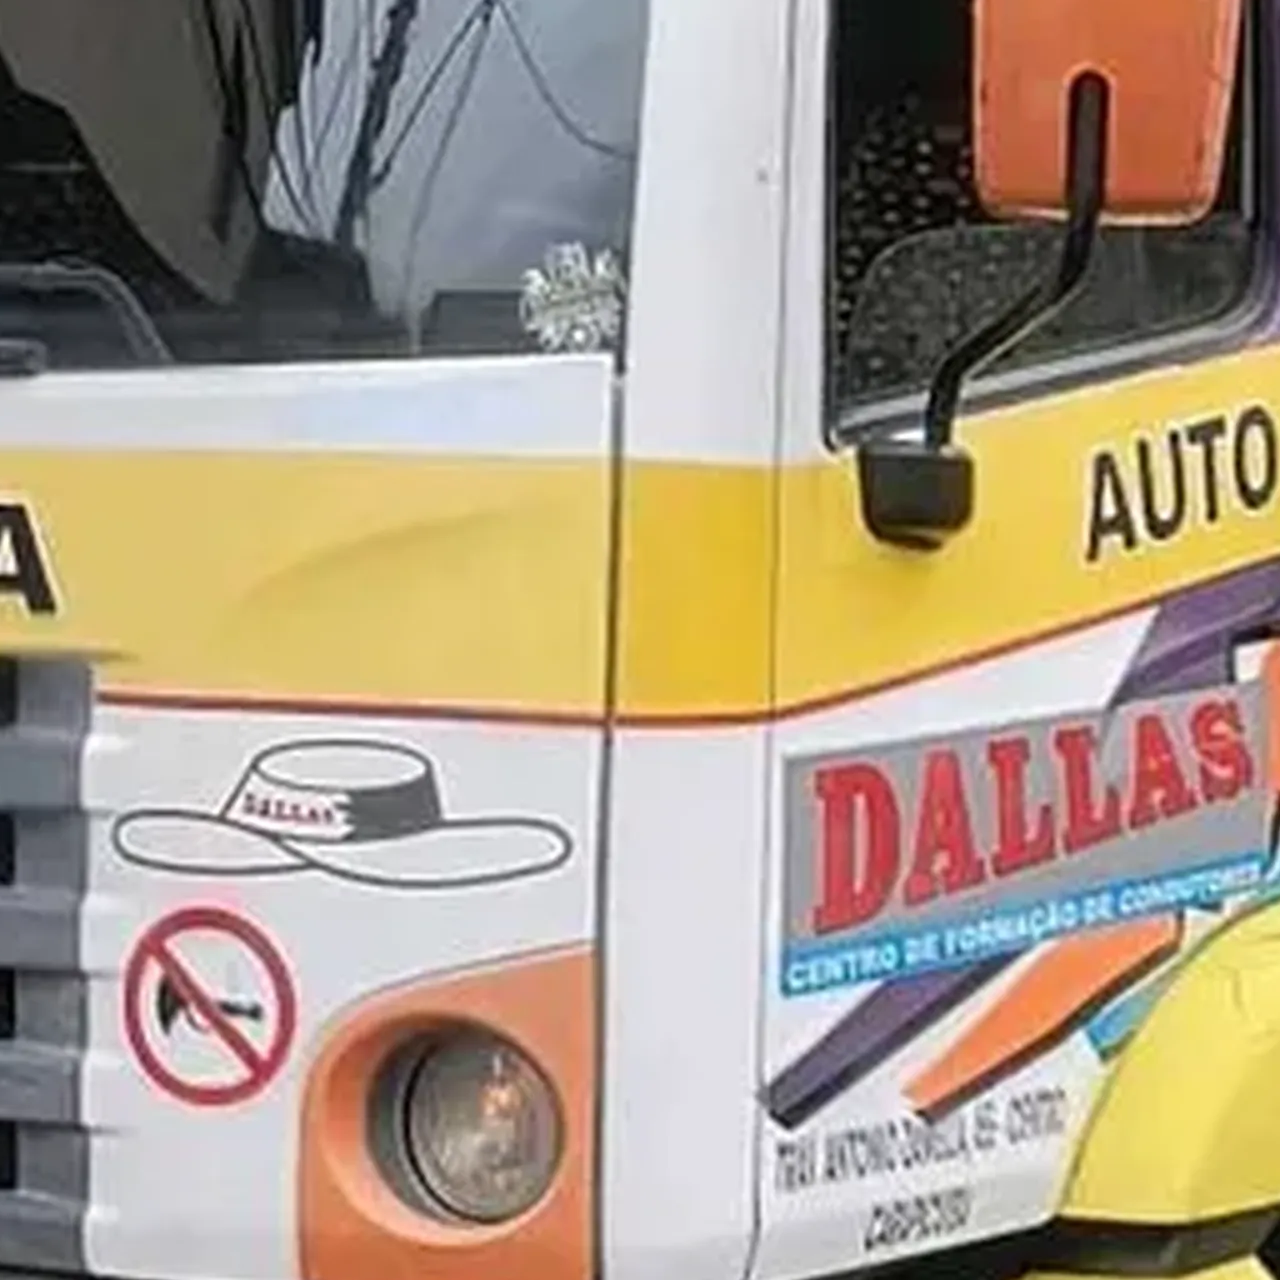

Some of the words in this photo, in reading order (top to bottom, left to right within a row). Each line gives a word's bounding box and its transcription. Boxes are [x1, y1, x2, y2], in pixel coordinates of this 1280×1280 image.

[1086, 405, 1278, 562] AUTO
[813, 702, 1254, 931] DALLAS
[787, 942, 899, 992] CENTRO
[903, 932, 942, 964] DE
[1082, 894, 1114, 922] DE
